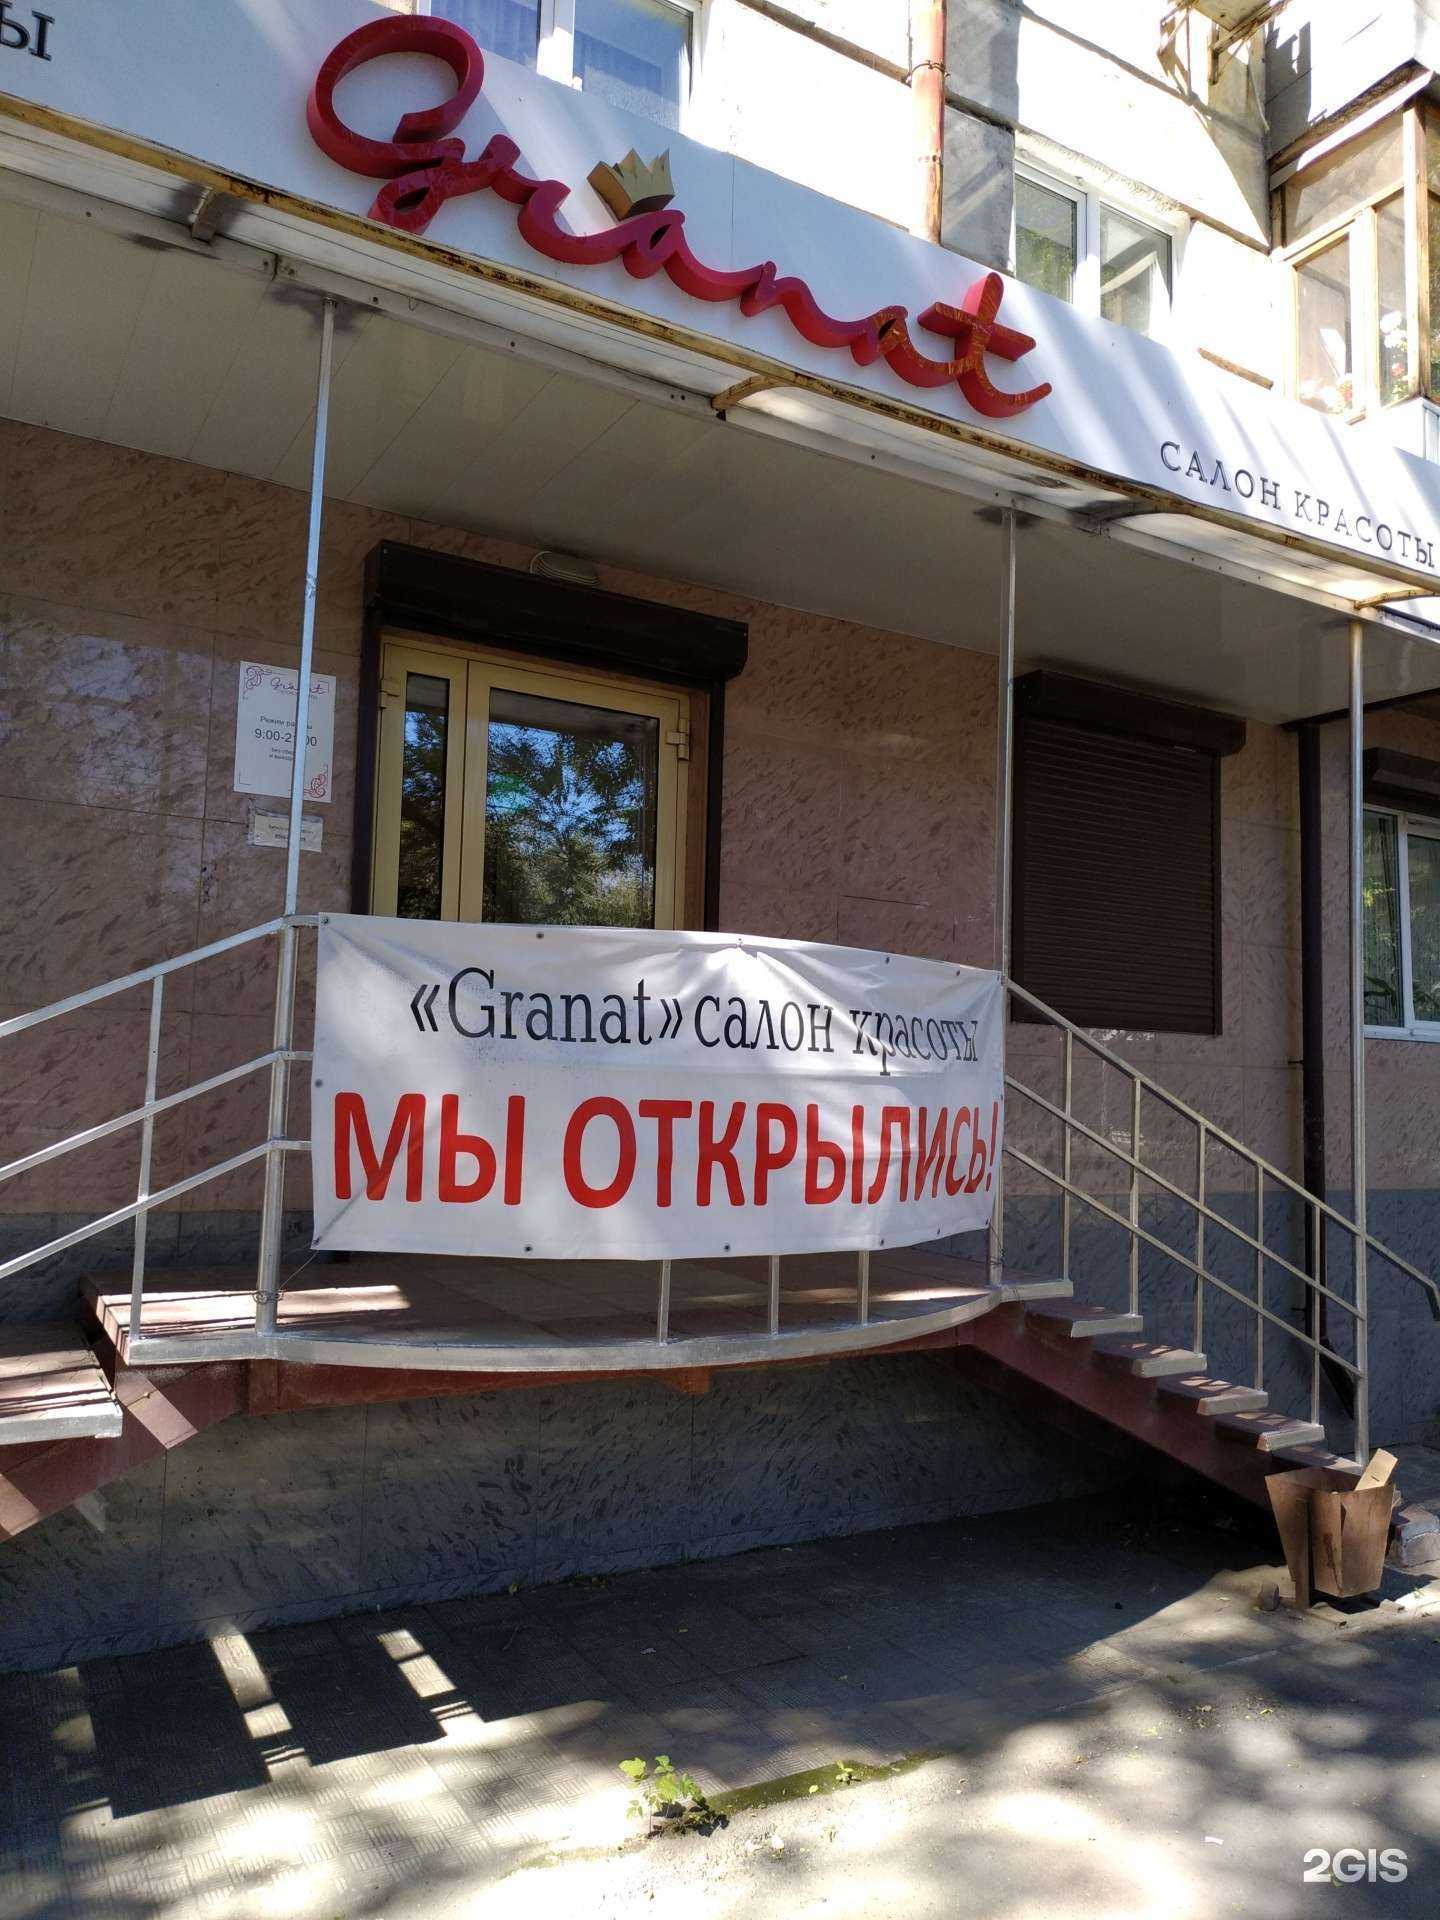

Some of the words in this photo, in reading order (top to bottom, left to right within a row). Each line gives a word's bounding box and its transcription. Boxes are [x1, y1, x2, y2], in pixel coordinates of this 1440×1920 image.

[307, 15, 1052, 419] Granat
[1160, 440, 1282, 511] САЛОН
[1294, 490, 1435, 568] КРАСОТЫ
[408, 966, 684, 1045] «Granat»
[694, 994, 834, 1053] салон
[848, 1007, 980, 1076] красоты
[334, 1092, 526, 1207] МЫ
[562, 1096, 999, 1209] ОТКРЫЛИСЬ!
